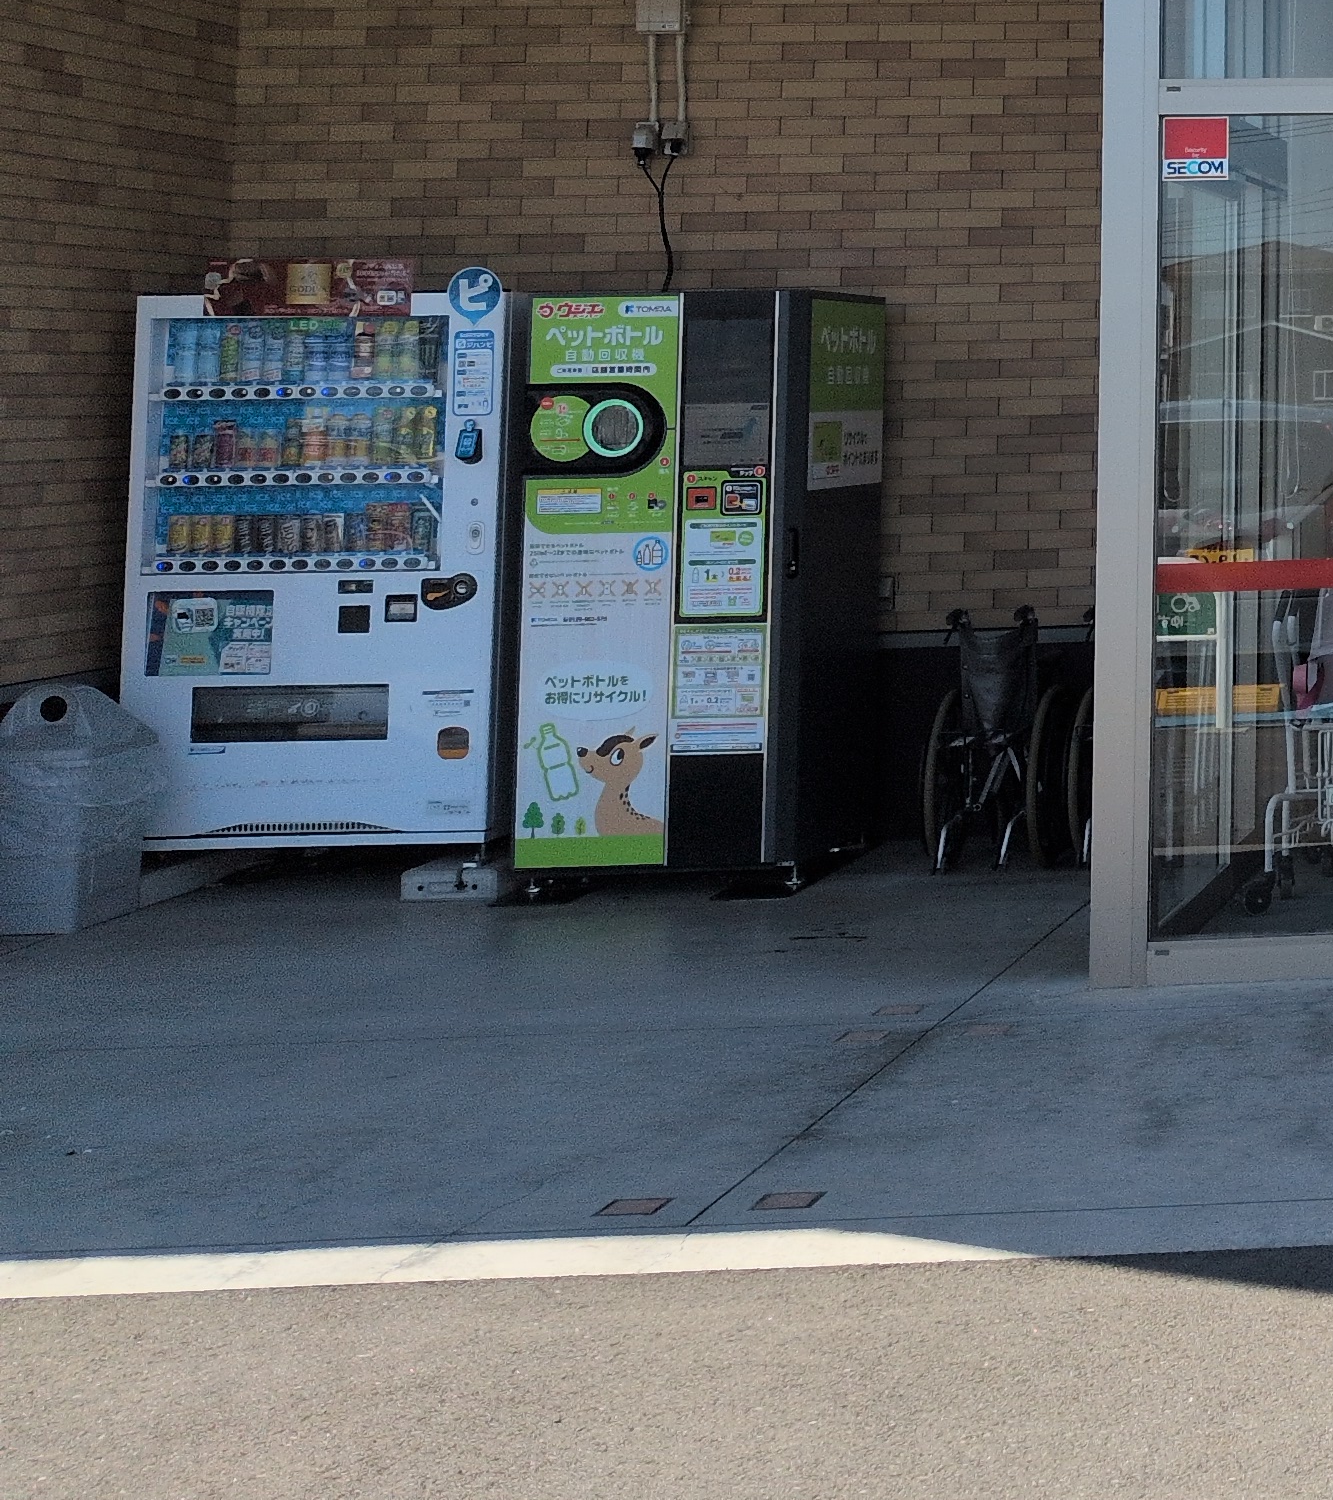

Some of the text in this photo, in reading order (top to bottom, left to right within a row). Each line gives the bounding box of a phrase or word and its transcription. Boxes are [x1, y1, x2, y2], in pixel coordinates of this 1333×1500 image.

[1167, 161, 1224, 175] SECOM
[460, 274, 493, 311] ピ
[290, 320, 318, 330] LED
[545, 325, 664, 347] ペットボトル
[820, 326, 877, 355] ペットボトル
[545, 674, 629, 687] ペットボトルを
